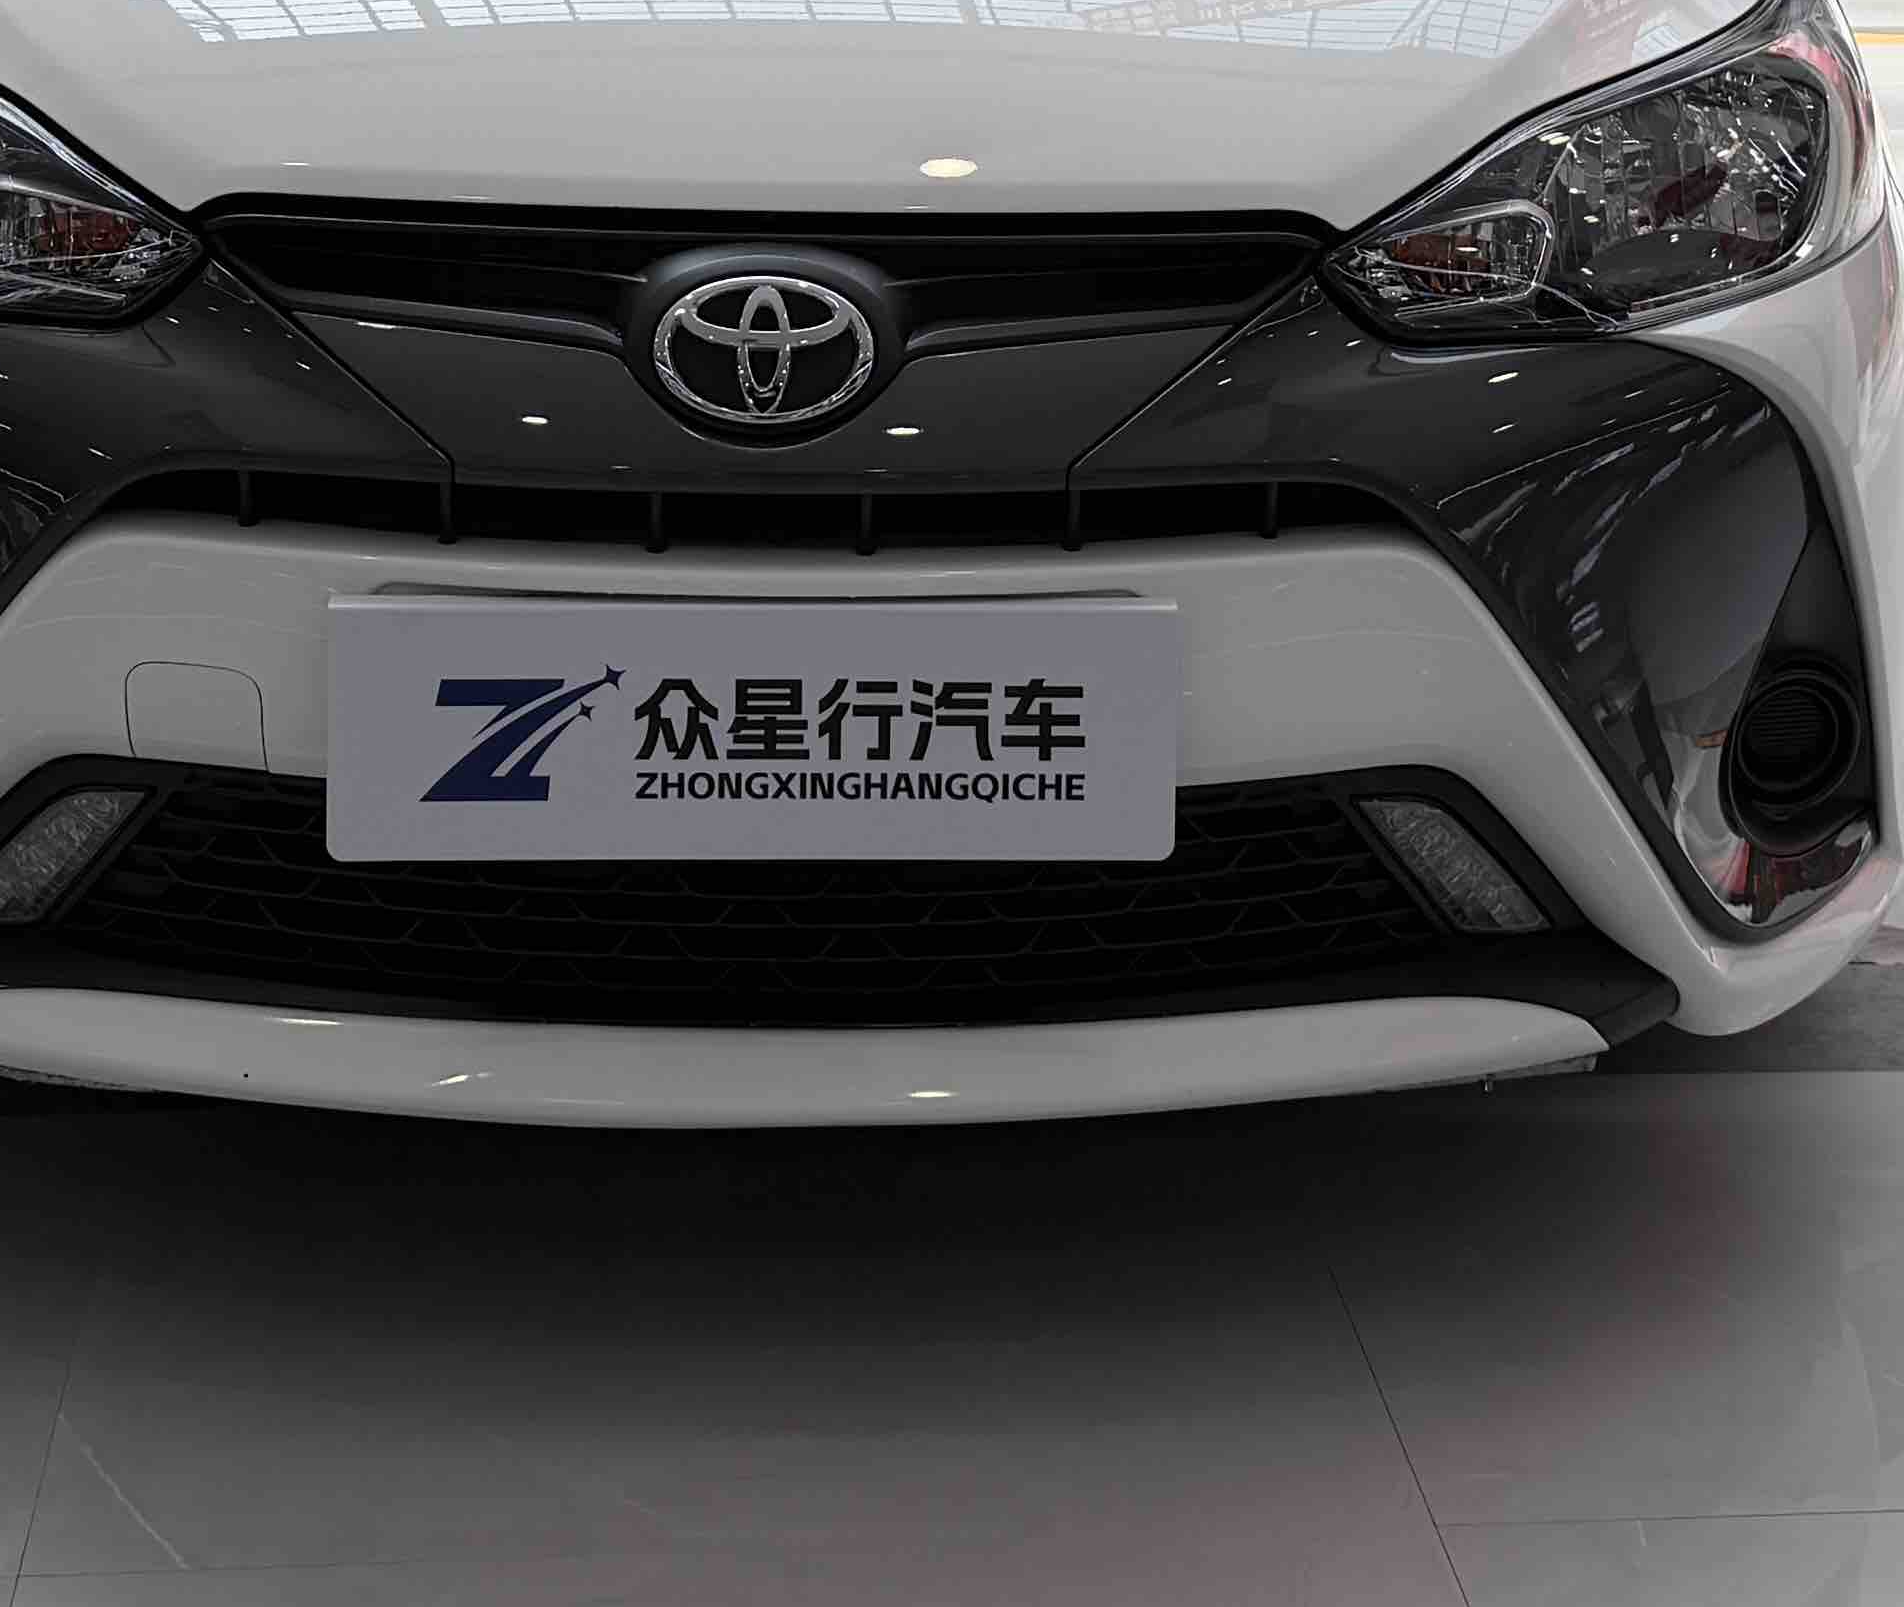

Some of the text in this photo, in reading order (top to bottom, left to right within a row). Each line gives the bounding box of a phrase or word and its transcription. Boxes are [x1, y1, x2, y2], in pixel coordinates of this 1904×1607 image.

[634, 677, 1087, 762] 众星行汽车
[635, 772, 1086, 804] ZHONGXINGHANGQICHE
